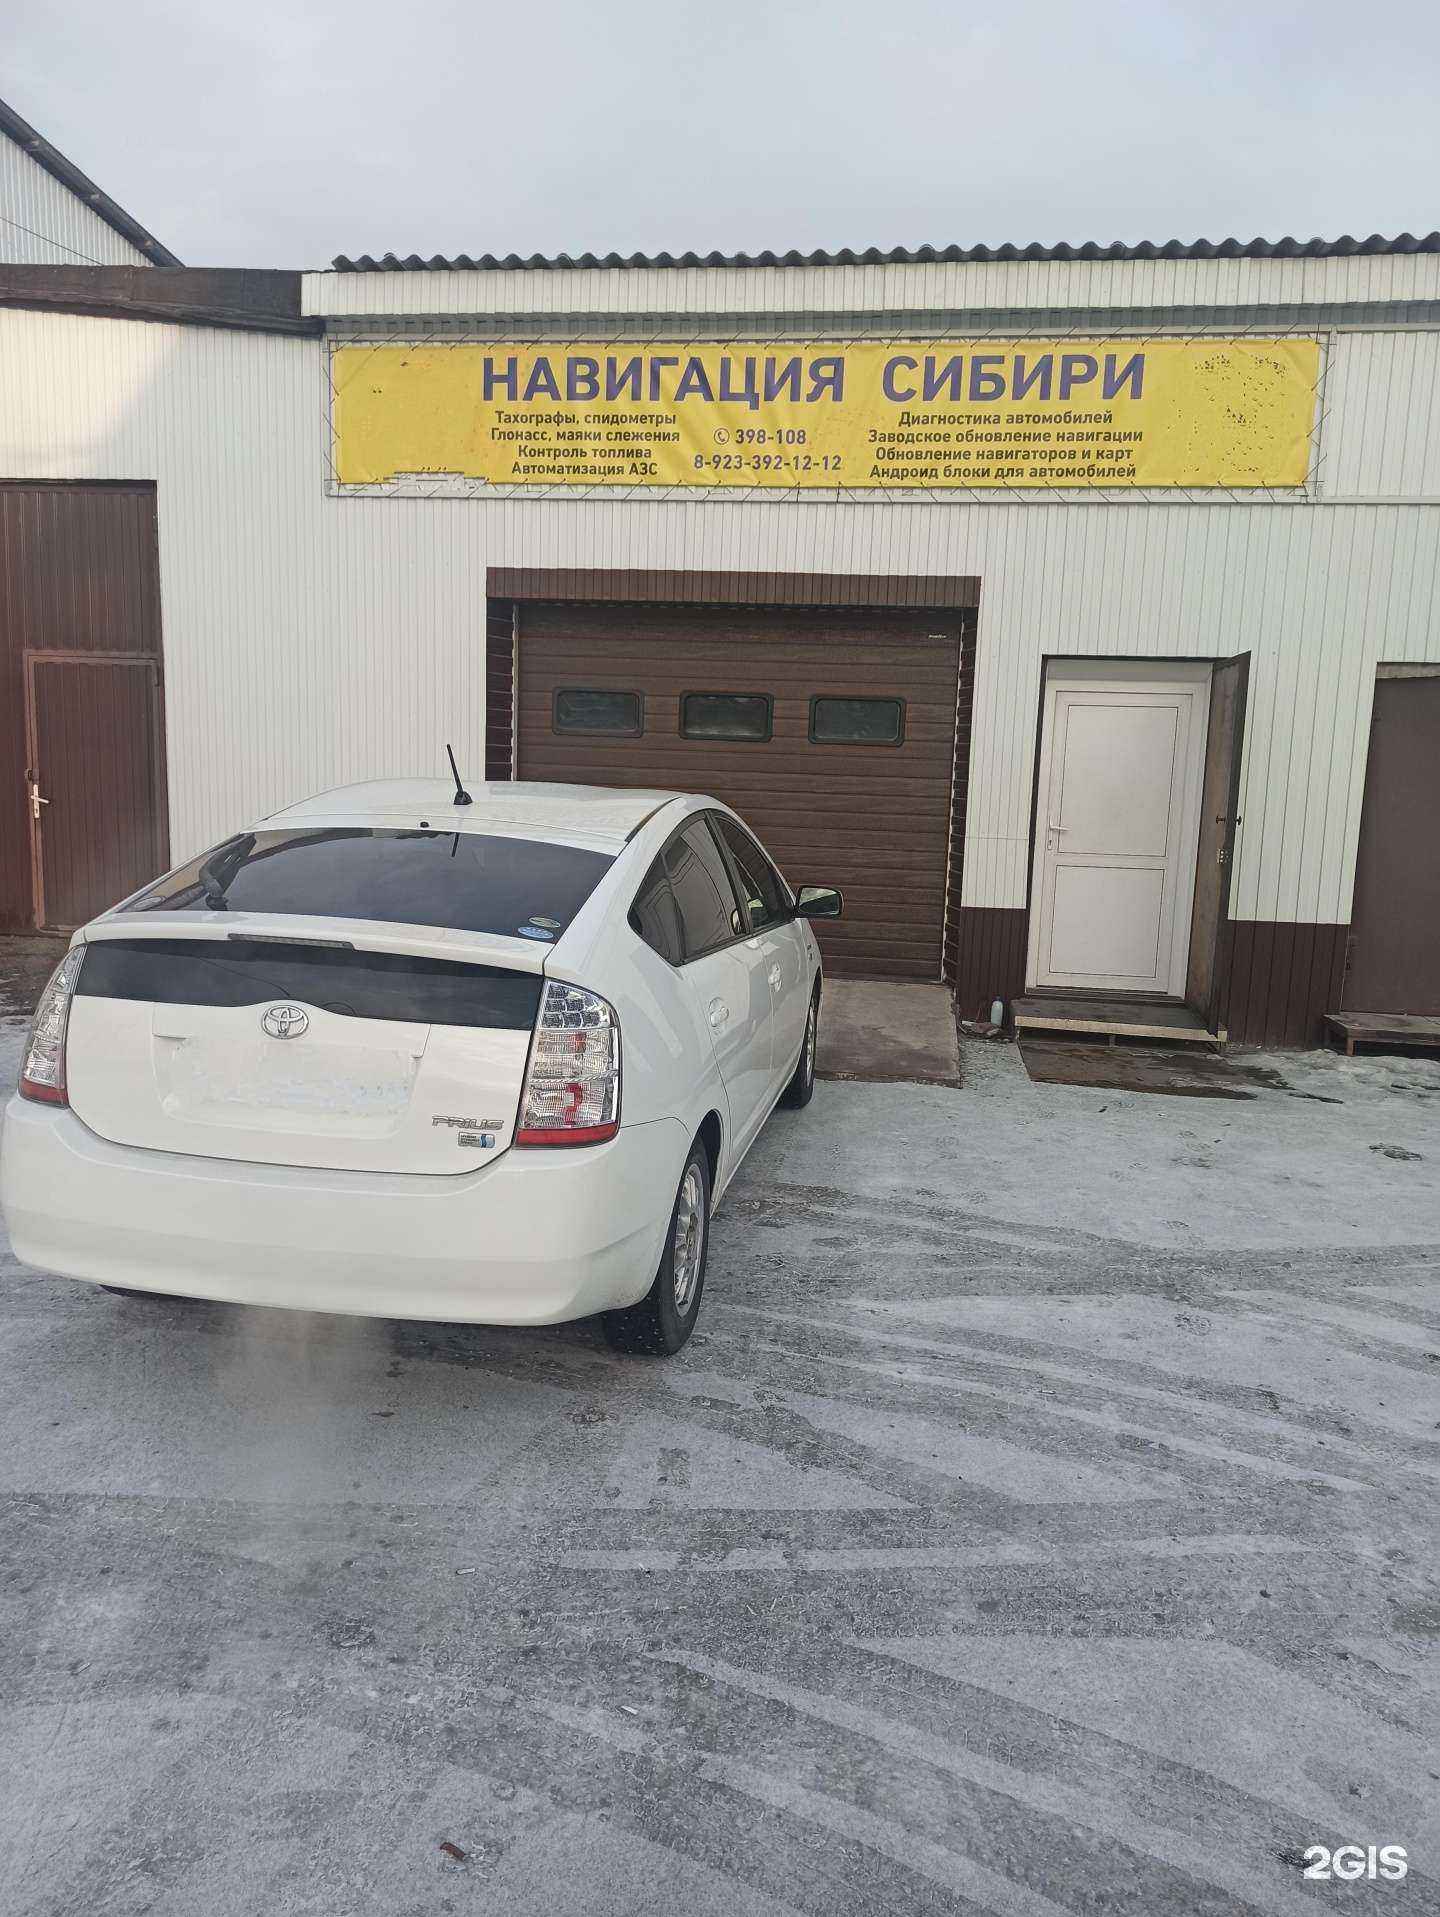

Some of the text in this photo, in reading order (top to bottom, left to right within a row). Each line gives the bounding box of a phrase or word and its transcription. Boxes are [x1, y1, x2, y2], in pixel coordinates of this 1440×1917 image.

[482, 353, 1145, 410] НАВИГАЦИЯ СИБИРИ
[495, 410, 677, 426] Тахографы, спидометры
[898, 410, 1113, 427] Диагностика автомобилей
[491, 428, 681, 442] Глонасс, маяки слежения
[735, 429, 806, 444] 398-108
[868, 429, 1143, 444] Заводское обновление навигации
[518, 445, 653, 460] Контроль топлива
[875, 446, 1134, 462] Обновление навигаторов и карт
[511, 462, 659, 476] Автоматизация АЗС
[694, 454, 842, 470] 8-923-392-12-12
[869, 464, 1137, 480] Андроид блоки для автомобилей
[431, 1114, 504, 1130] PRIUS
